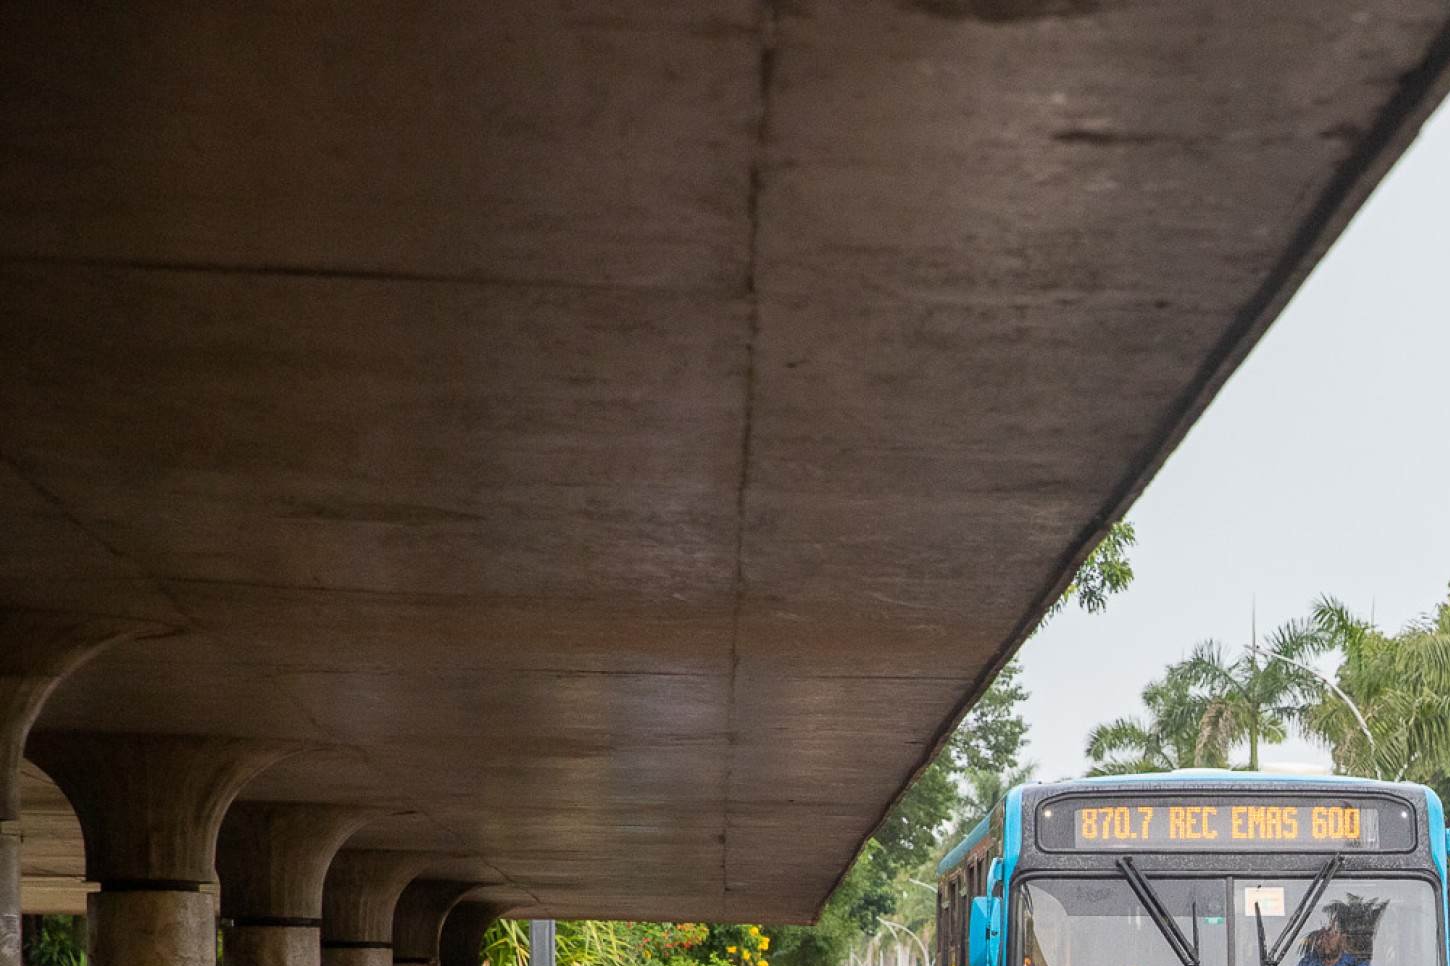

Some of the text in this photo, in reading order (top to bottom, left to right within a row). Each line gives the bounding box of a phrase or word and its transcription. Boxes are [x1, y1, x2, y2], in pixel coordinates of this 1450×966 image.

[1081, 806, 1361, 840] 870.7 REC EMAS 600
